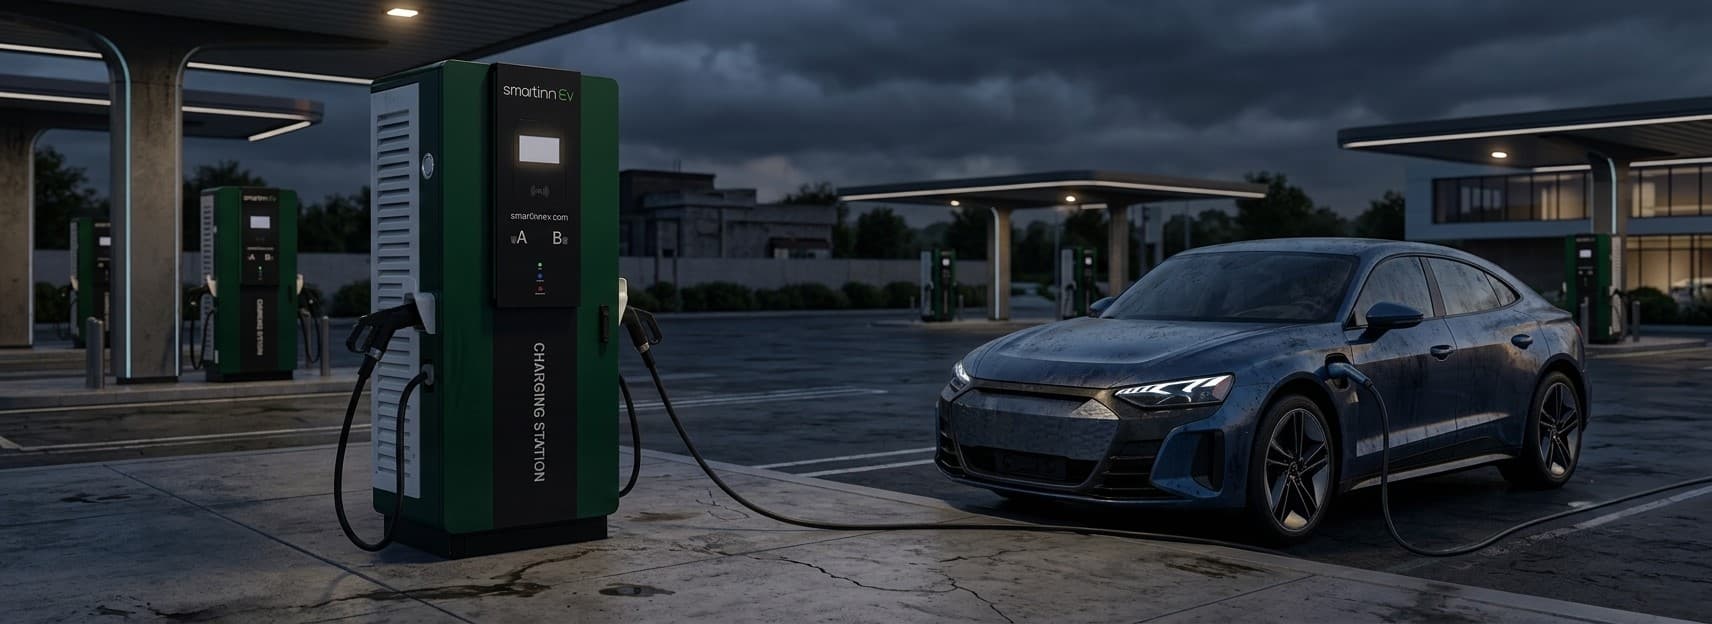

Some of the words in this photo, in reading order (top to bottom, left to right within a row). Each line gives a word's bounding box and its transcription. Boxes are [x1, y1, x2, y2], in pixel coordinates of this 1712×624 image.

[503, 85, 557, 100] smartinn
[516, 230, 528, 244] A
[552, 231, 562, 245] B
[533, 342, 546, 418] CHARGING
[533, 422, 546, 482] STATION
